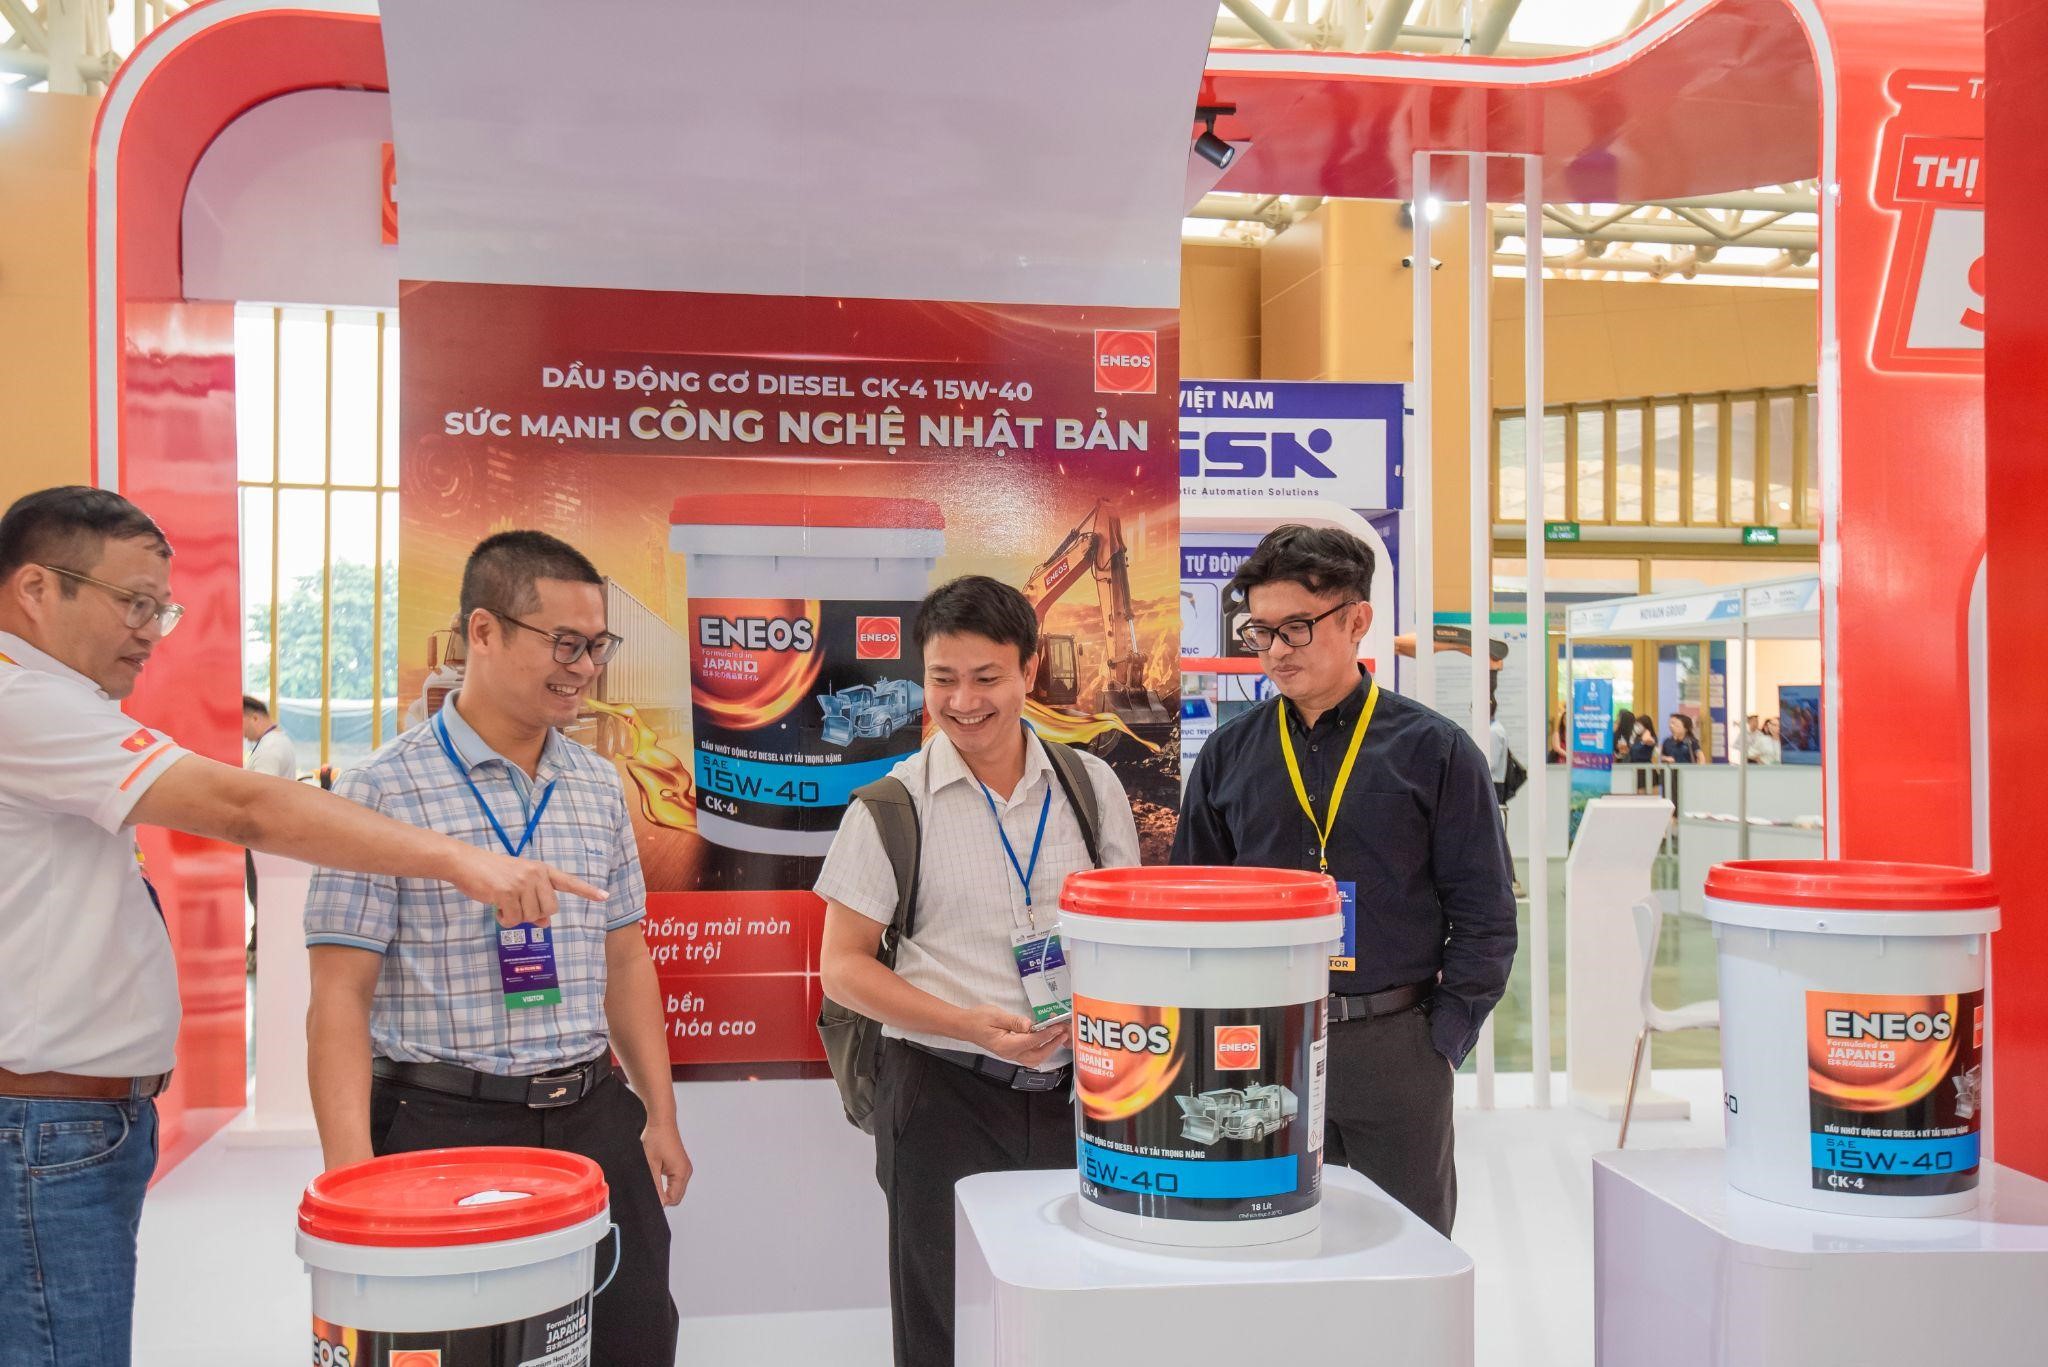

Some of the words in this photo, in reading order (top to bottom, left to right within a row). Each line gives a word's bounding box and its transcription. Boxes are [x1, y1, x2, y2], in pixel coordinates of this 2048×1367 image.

[1968, 78, 1985, 99] T
[1913, 155, 1980, 198] THỊ
[1100, 354, 1151, 368] ENEOS
[542, 361, 605, 389] DẦU
[613, 365, 700, 396] ĐỘNG
[708, 370, 750, 393] CƠ
[758, 374, 854, 397] DIESEL
[861, 377, 927, 399] CK-4
[934, 379, 1033, 402] 15W-40
[1222, 391, 1274, 409] NAM
[444, 406, 512, 436] SỨC
[521, 414, 620, 444] MẠNH
[629, 399, 764, 443] CÔNG
[780, 406, 906, 455] NGHỆ
[920, 408, 1043, 457] NHẬT
[1055, 407, 1148, 450] BẢN
[1202, 487, 1264, 496] Automation
[1268, 487, 1319, 496] Solutions
[1046, 562, 1068, 586] ENEOS
[1185, 553, 1207, 576] TỰ
[699, 616, 814, 651] ENEOS
[860, 633, 897, 642] ENEOS
[702, 648, 744, 659] Formulated
[703, 658, 743, 671] JAPAN
[703, 756, 729, 770] SAE
[758, 752, 779, 762] DIESEL
[703, 767, 820, 803] 15W-40
[705, 795, 735, 815] CK-4
[704, 917, 742, 936] mài
[747, 916, 791, 936] mòn
[686, 941, 722, 965] trội
[667, 991, 705, 1013] bền
[675, 1018, 713, 1037] hóa
[718, 1020, 756, 1036] cao
[1077, 1013, 1171, 1055] ENEOS
[1826, 1010, 1952, 1041] ENEOS
[1219, 1043, 1256, 1052] ENEOS
[1826, 1038, 1878, 1049] Formulated
[1880, 1041, 1888, 1049] in
[1828, 1049, 1876, 1060] JAPAN
[1894, 1128, 1916, 1138] DIESEL
[1114, 1142, 1134, 1153] DIESEL
[1161, 1148, 1184, 1159] TRỌNG
[1185, 1149, 1206, 1160] NẶNG
[1826, 1138, 1856, 1148] SAE
[1826, 1148, 1952, 1171] 15W-40
[1082, 1181, 1099, 1199] CK-4
[1827, 1174, 1864, 1190] CK-4
[546, 1319, 579, 1344] JAPAN
